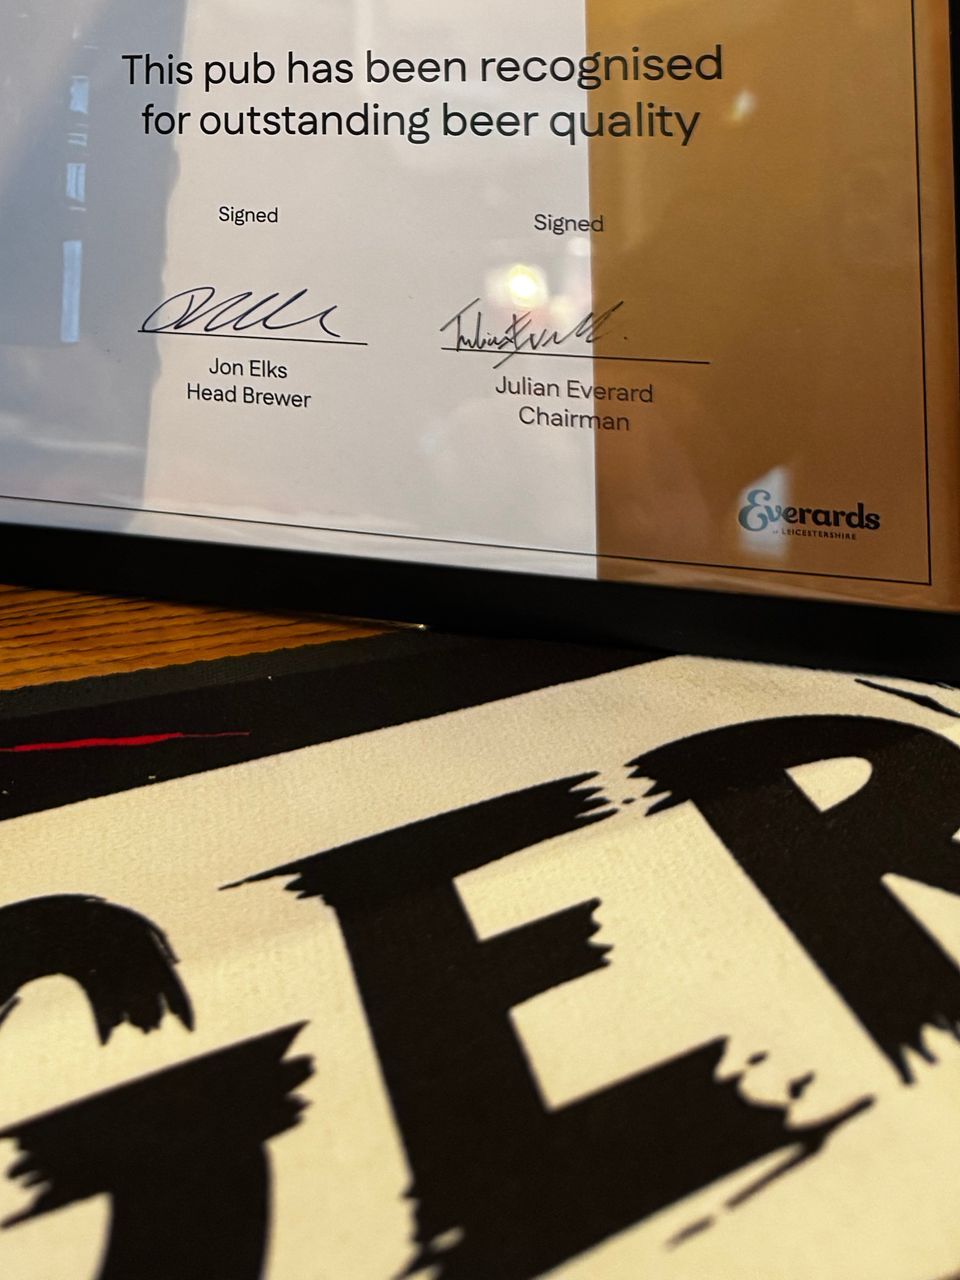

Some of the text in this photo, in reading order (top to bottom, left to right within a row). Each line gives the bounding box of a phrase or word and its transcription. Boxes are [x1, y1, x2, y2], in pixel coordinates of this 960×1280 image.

[122, 44, 724, 92] This pub has been recognised
[142, 102, 700, 146] for outstanding beer quality
[218, 206, 279, 227] Signed
[533, 213, 604, 235] Signed
[208, 357, 288, 380] Jon Elks
[186, 383, 312, 409] Head Brewer
[495, 376, 654, 404] Julian Everard
[518, 406, 631, 432] Chairman
[738, 489, 881, 531] Everards
[781, 528, 857, 541] LEICESTERSHIRE
